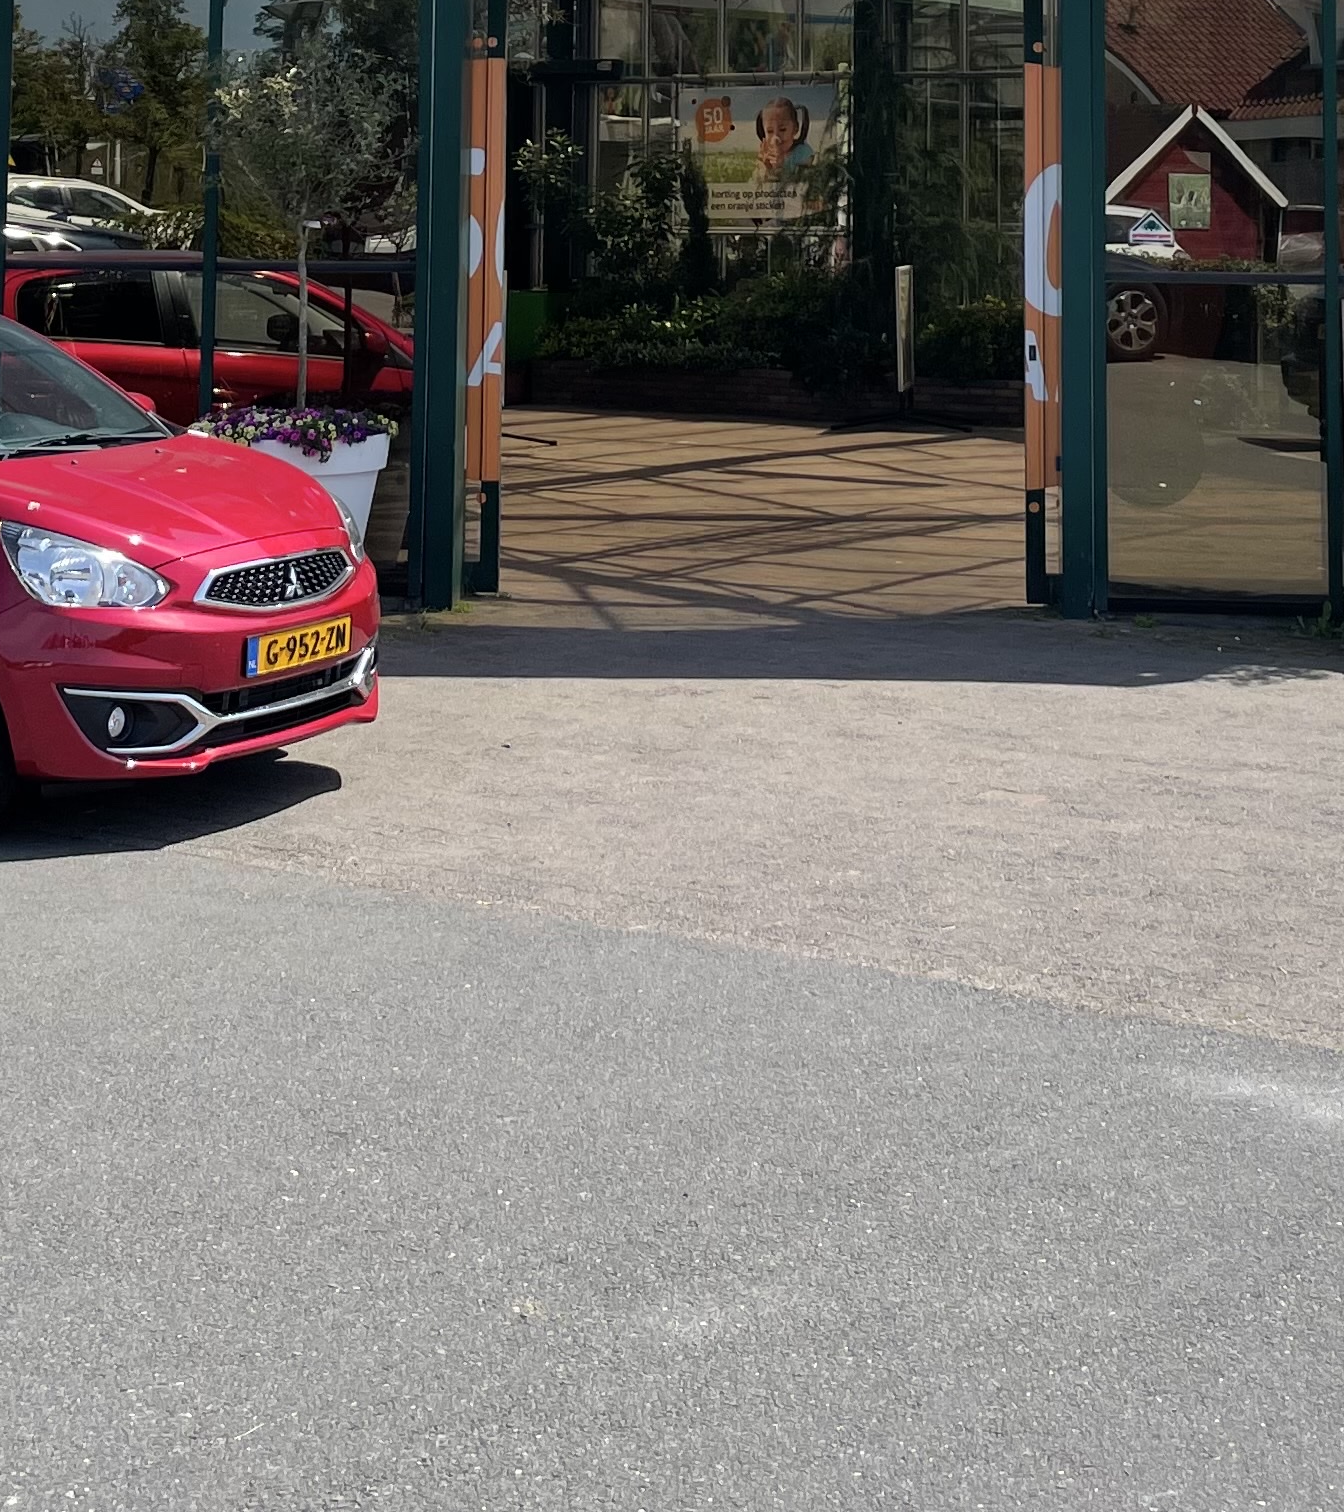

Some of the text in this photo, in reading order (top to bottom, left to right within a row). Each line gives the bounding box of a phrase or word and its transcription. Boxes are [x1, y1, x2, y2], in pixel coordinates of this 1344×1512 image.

[703, 106, 723, 126] 50
[742, 191, 754, 200] op
[711, 202, 726, 210] een
[266, 622, 347, 665] G-952-ZN
